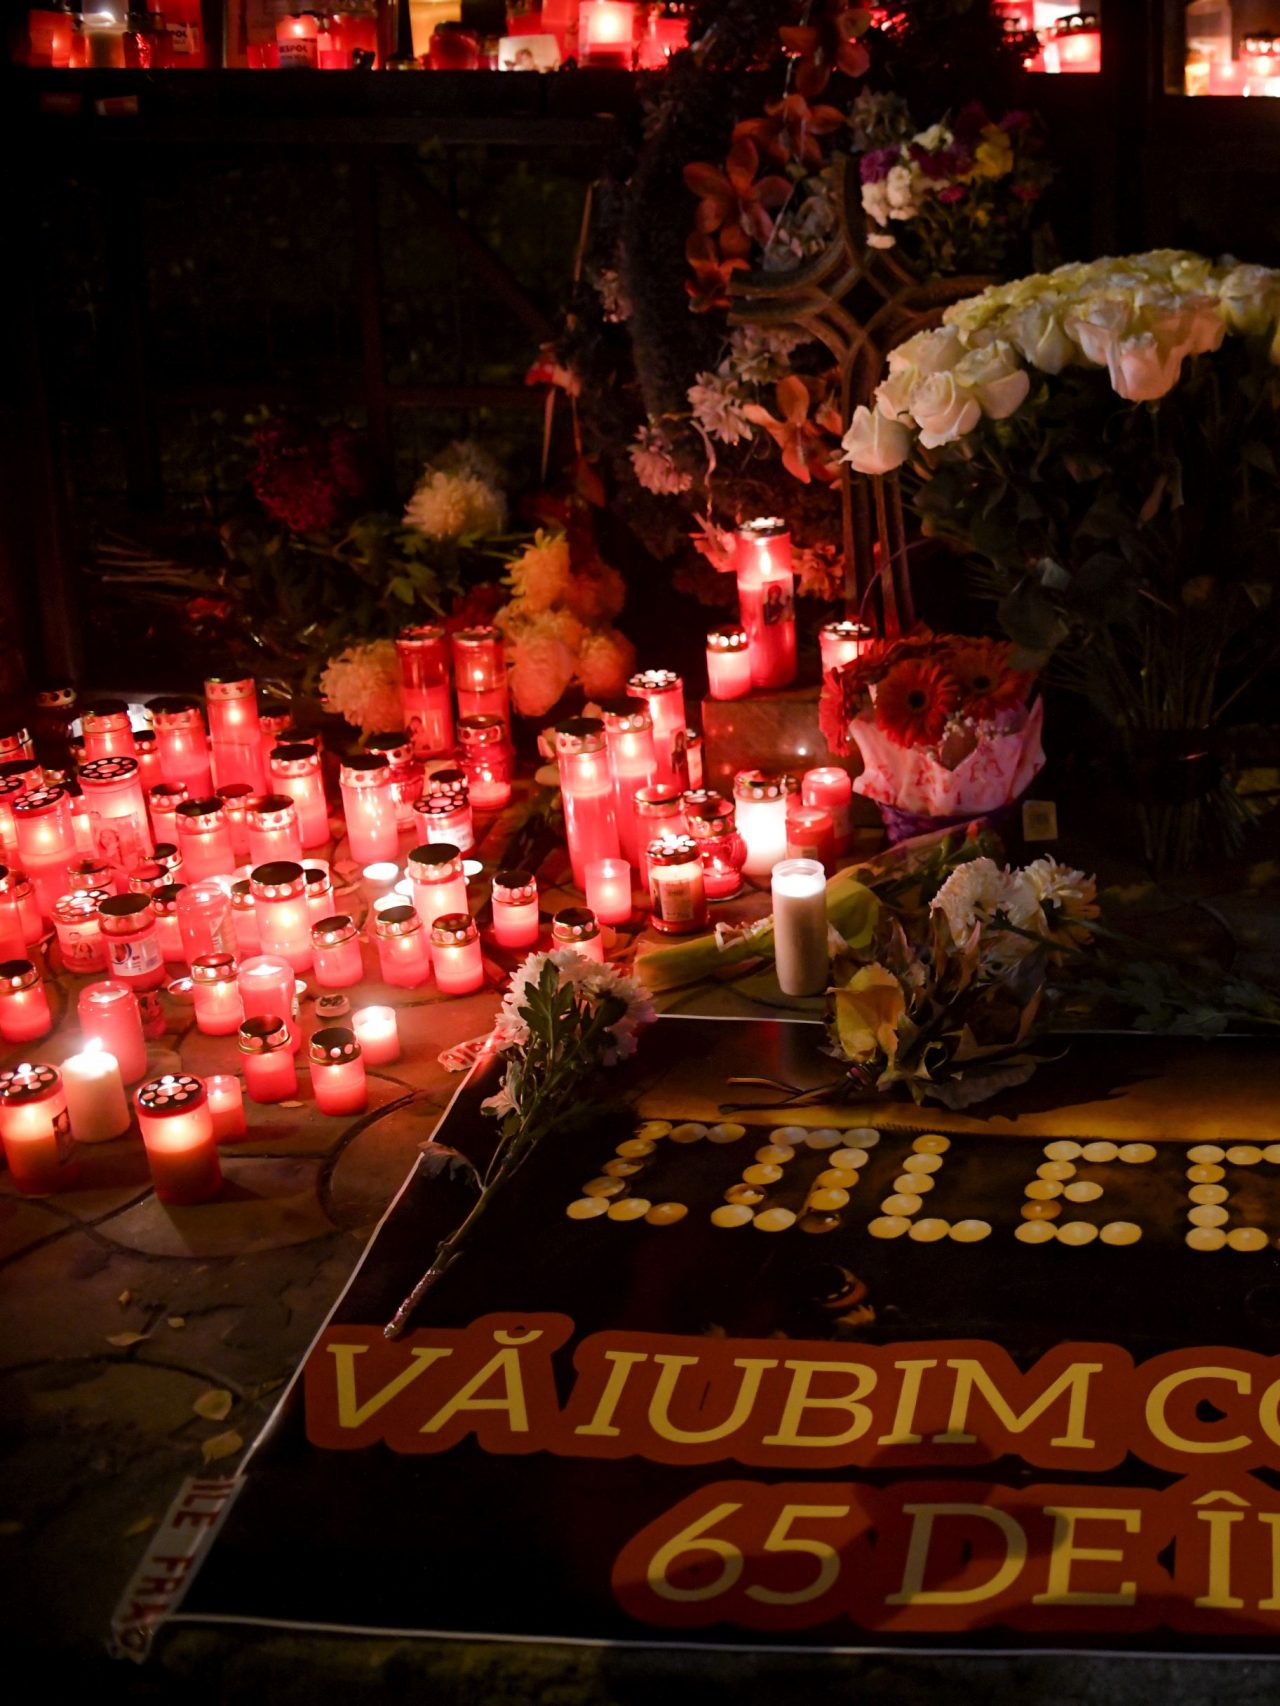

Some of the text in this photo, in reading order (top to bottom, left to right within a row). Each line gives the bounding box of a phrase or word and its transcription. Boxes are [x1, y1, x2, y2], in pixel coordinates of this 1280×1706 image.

[325, 1329, 543, 1433] VĂ
[573, 1350, 1104, 1450] IUBIM
[646, 1502, 850, 1605] 65
[884, 1502, 1143, 1606] DE
